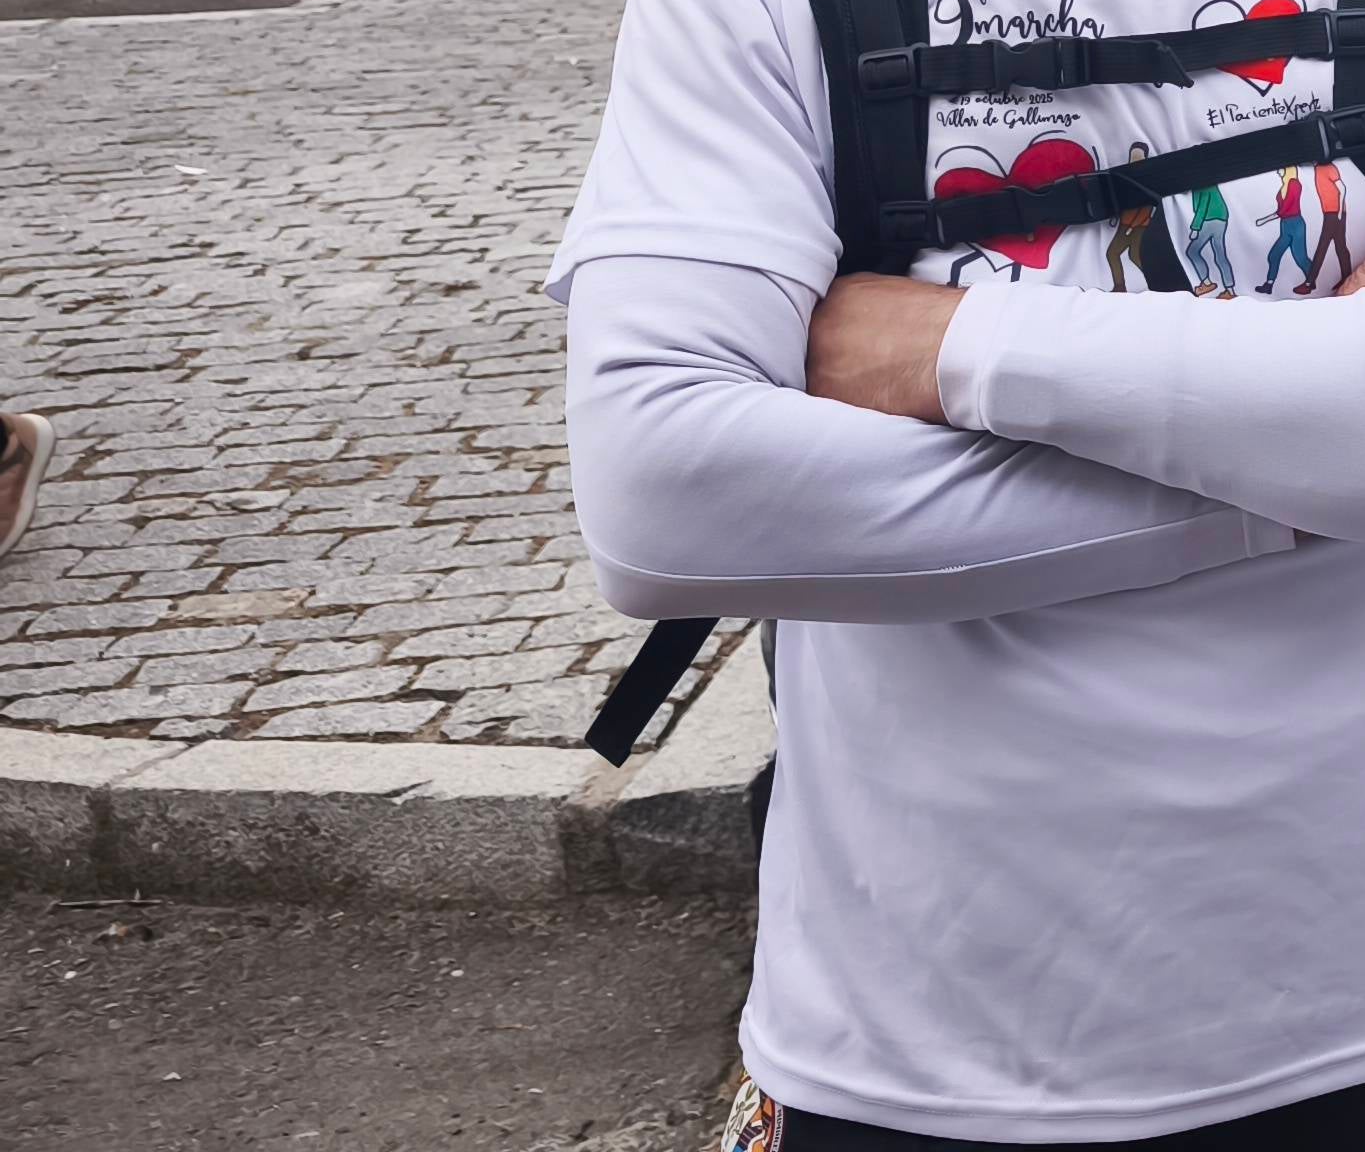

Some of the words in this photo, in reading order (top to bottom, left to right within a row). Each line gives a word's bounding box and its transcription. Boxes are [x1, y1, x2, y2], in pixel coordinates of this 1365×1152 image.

[975, 89, 1025, 105] octubre
[1028, 92, 1054, 104] 2025
[936, 108, 979, 128] Villar
[982, 107, 999, 123] de
